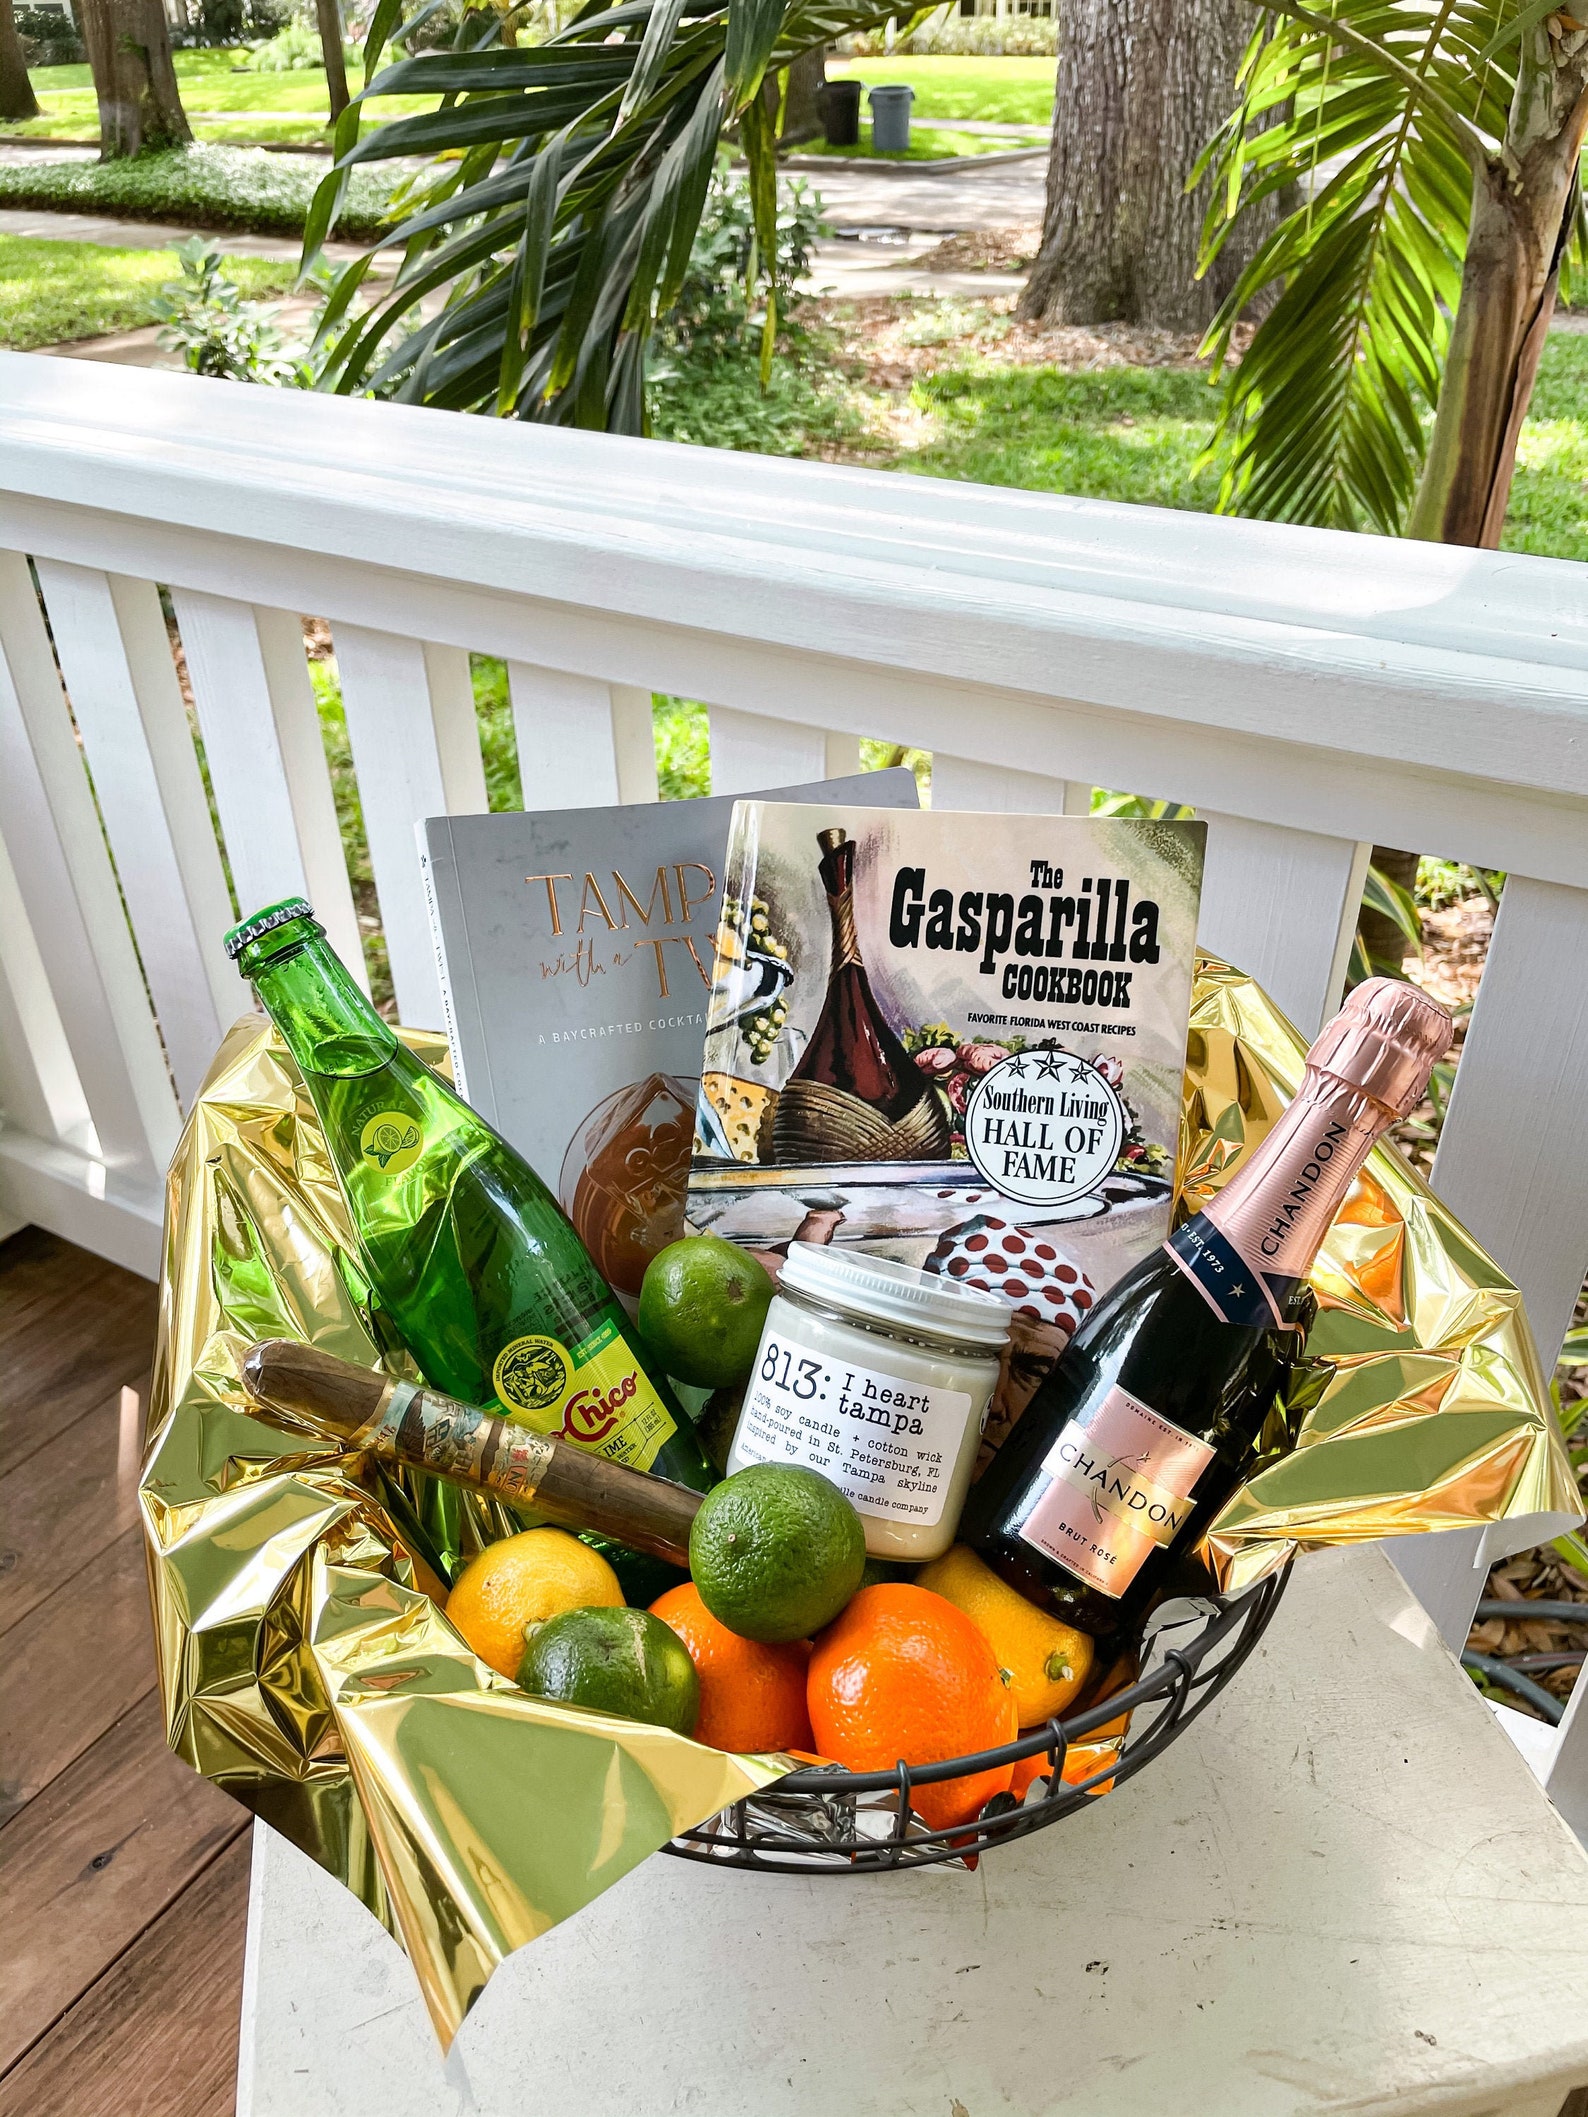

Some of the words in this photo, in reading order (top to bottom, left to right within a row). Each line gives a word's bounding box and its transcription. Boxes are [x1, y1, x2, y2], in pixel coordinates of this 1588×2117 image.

[1030, 860, 1064, 889] The
[525, 863, 717, 936] TAMP
[889, 866, 1161, 975] Gasparilla
[539, 937, 607, 988] with
[1002, 963, 1133, 1009] COOKBOOK
[538, 1034, 547, 1046] A
[552, 1022, 643, 1044] BAYCRAFTED
[967, 1012, 1008, 1026] FAVORITE
[1009, 1015, 1046, 1030] FLORIDA
[1047, 1019, 1072, 1032] WEST
[1071, 1020, 1100, 1034] COAST
[1100, 1023, 1137, 1037] RECIPES
[982, 1083, 1055, 1116] Southern
[1059, 1091, 1109, 1127] Living
[982, 1117, 1054, 1150] HALL
[1064, 1126, 1105, 1156] OF
[1001, 1150, 1077, 1184] FAME
[1259, 1121, 1347, 1256] CHANDON
[1187, 1231, 1203, 1251] EST.
[1201, 1249, 1225, 1274] 1973
[761, 1343, 831, 1400] 813:
[841, 1373, 856, 1393] I
[862, 1378, 931, 1414] heart
[563, 1370, 638, 1443] Chico
[754, 1391, 771, 1409] 100%
[775, 1405, 793, 1420] soy
[799, 1416, 841, 1438] candle
[868, 1439, 909, 1458] cotton
[917, 1451, 943, 1464] wick
[839, 1394, 924, 1436] tampa
[602, 1435, 628, 1458] IME
[750, 1404, 803, 1441] hand-poured
[808, 1435, 821, 1448] in
[827, 1441, 843, 1455] St.
[849, 1448, 921, 1478] Petersburg,
[926, 1467, 940, 1479] FL
[785, 1440, 799, 1456] by
[809, 1453, 831, 1467] our
[842, 1462, 886, 1484] Tampa
[897, 1478, 938, 1494] skyline
[1059, 1442, 1183, 1531] CHANDON
[857, 1492, 890, 1507] candle
[891, 1502, 929, 1515] company
[1058, 1522, 1088, 1546] BRUT
[1089, 1543, 1118, 1565] ROSÉ
